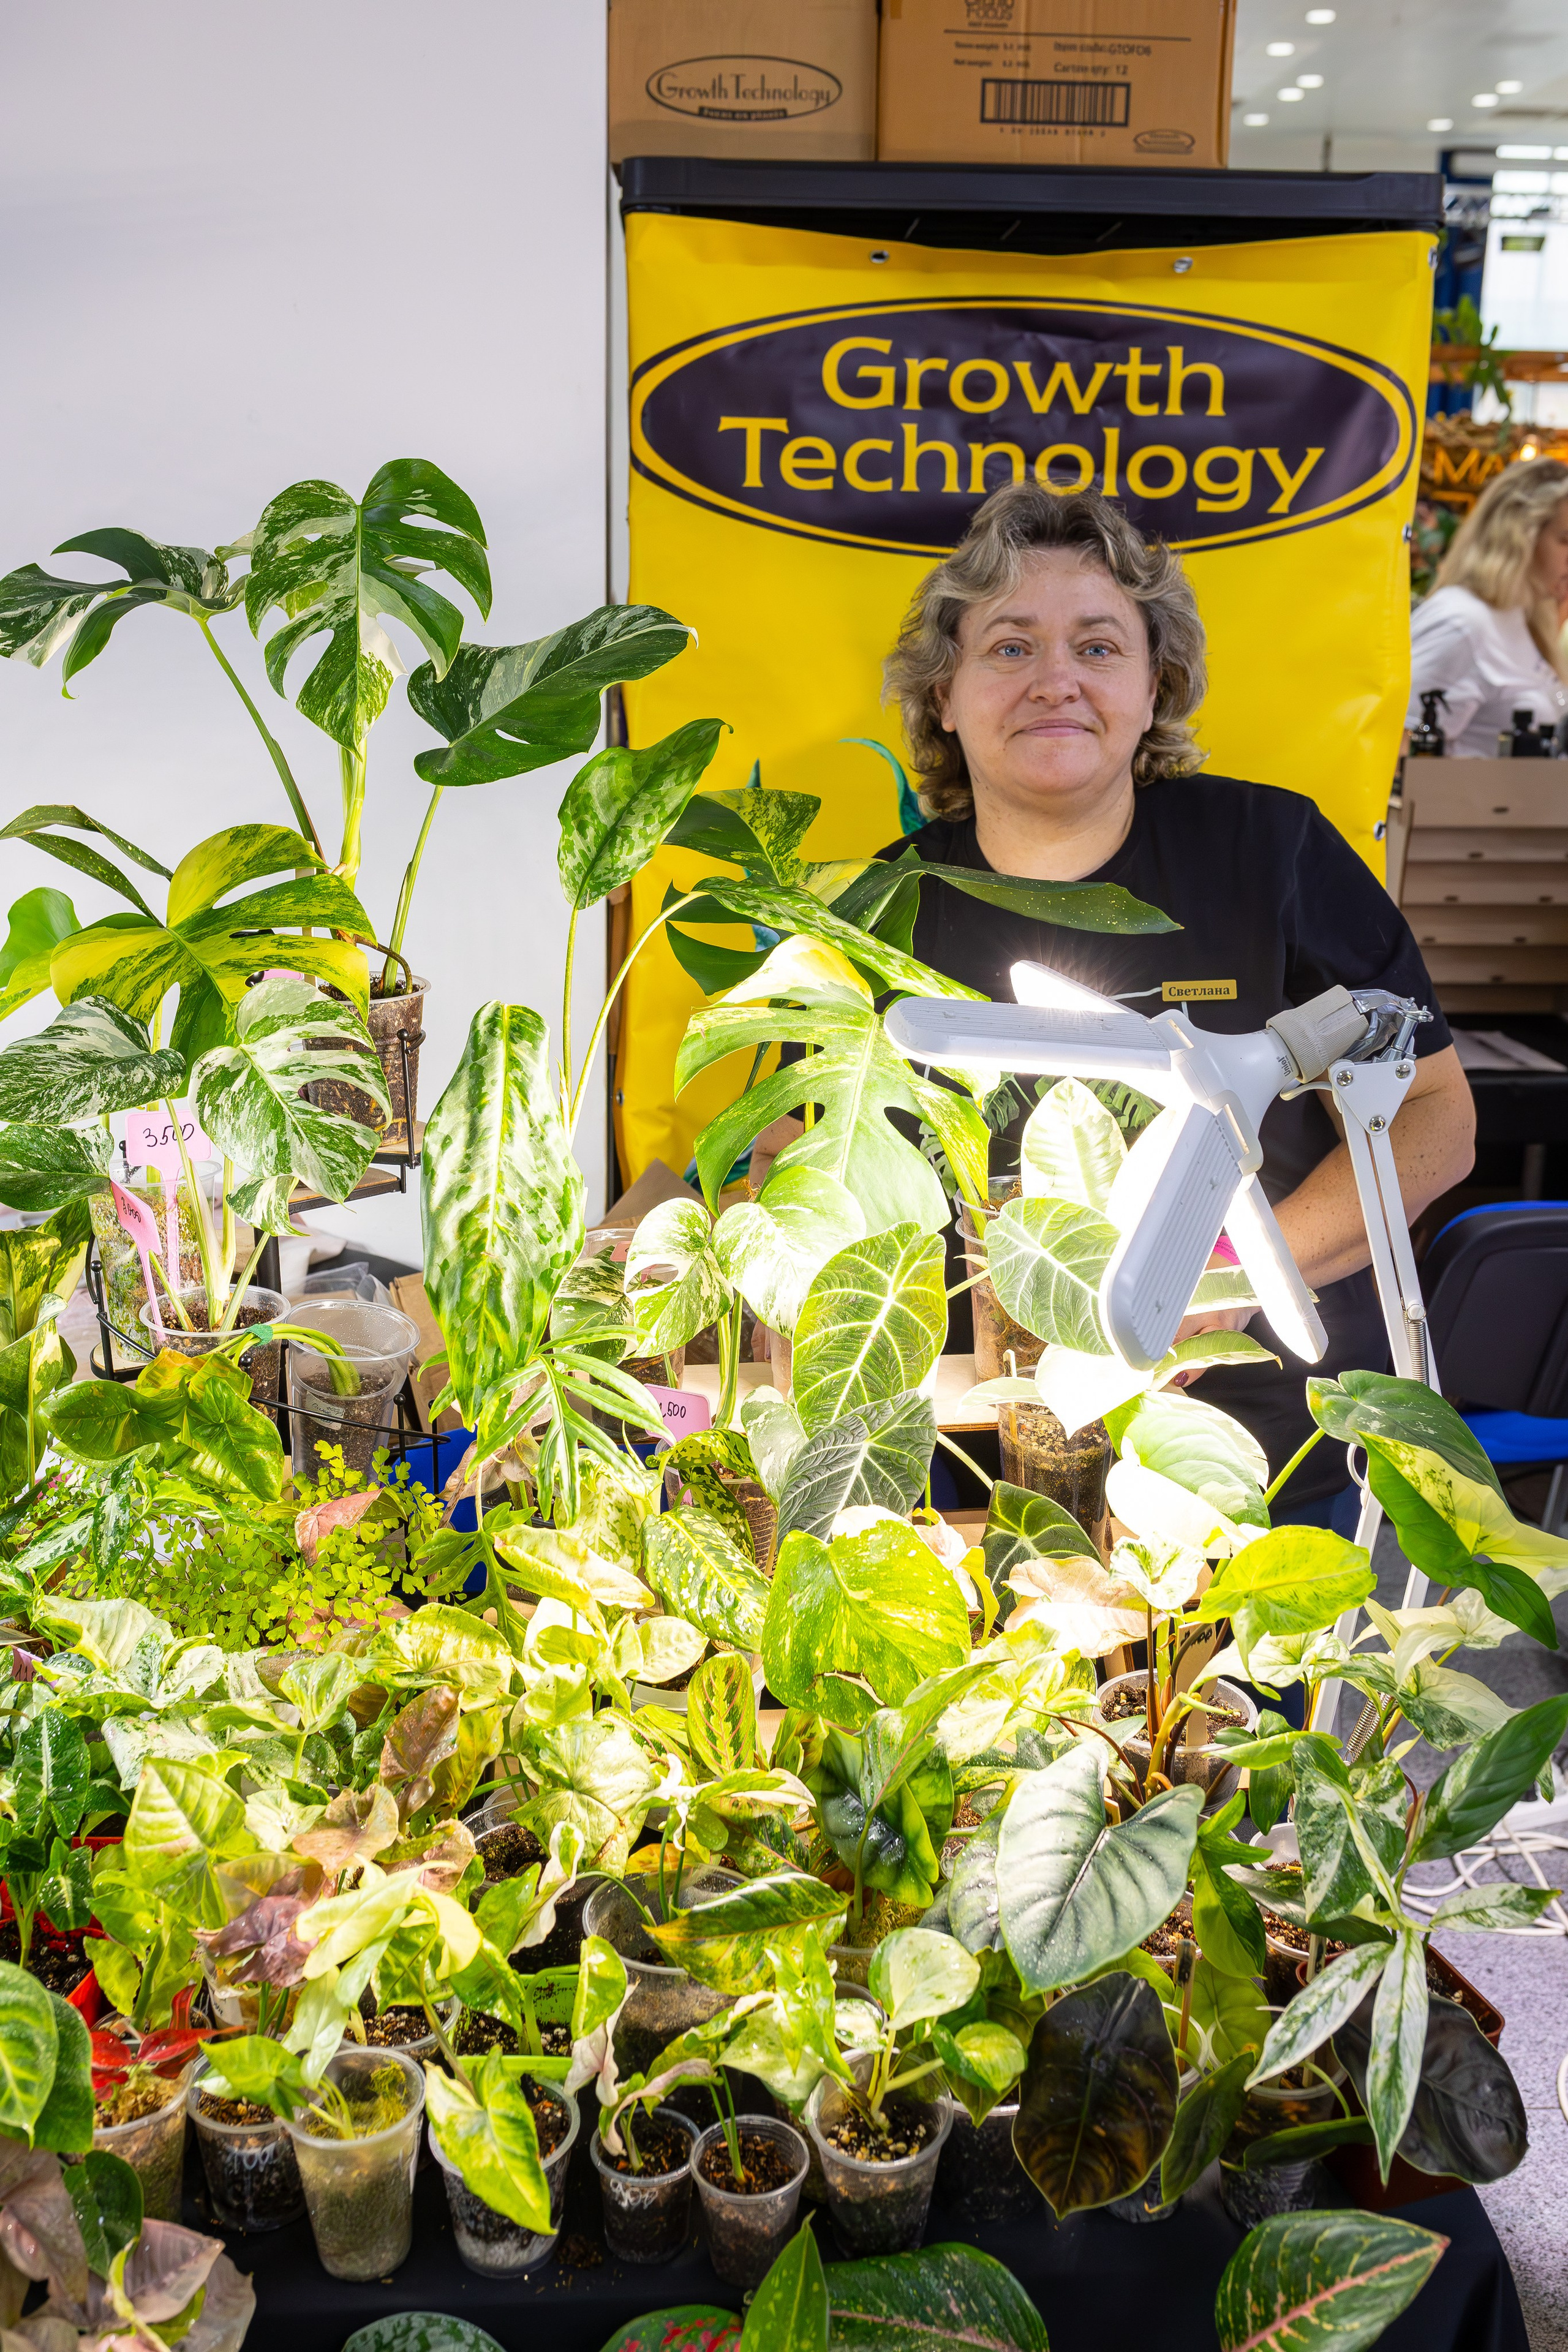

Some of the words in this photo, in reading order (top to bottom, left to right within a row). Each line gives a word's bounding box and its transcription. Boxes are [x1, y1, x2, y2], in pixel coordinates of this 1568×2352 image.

[657, 71, 728, 100] Growth
[730, 73, 830, 108] Technology
[821, 336, 1227, 417] Growth
[717, 415, 1326, 514] Technology
[1168, 987, 1231, 997] Светлана
[143, 1123, 194, 1147] 3500
